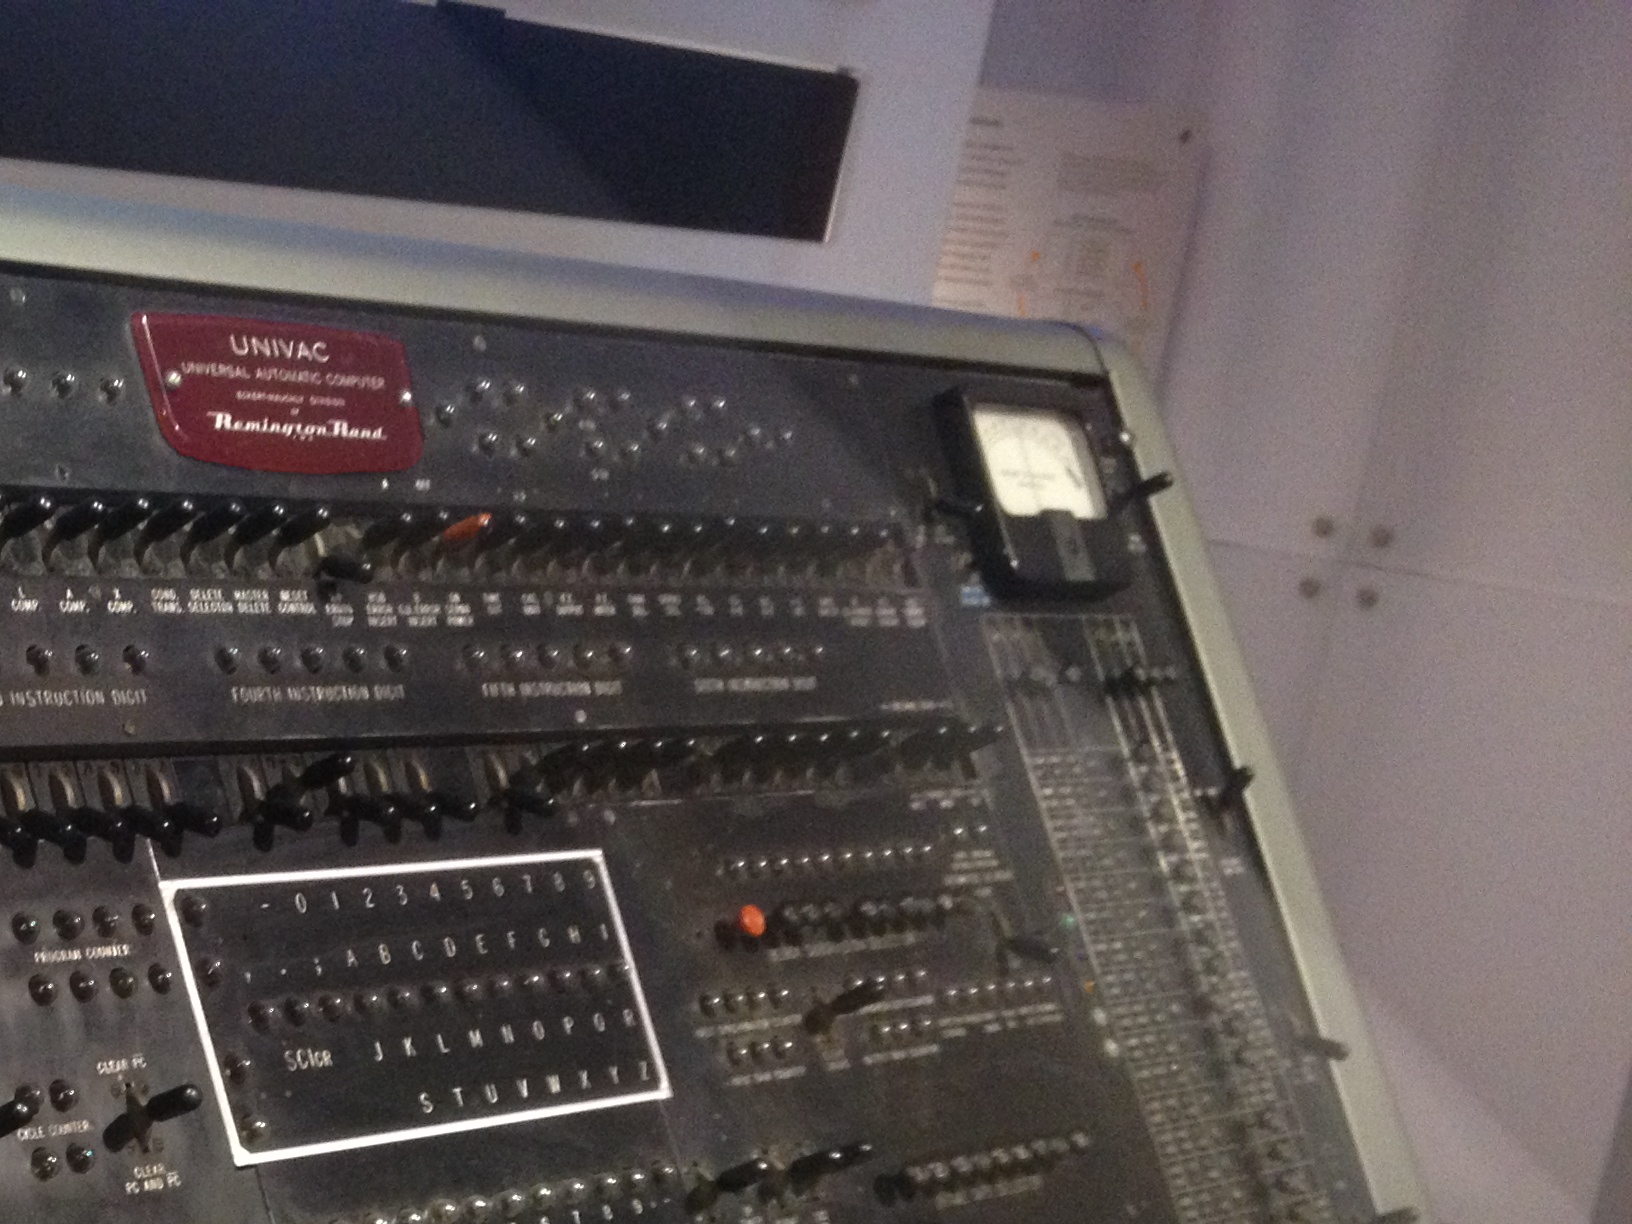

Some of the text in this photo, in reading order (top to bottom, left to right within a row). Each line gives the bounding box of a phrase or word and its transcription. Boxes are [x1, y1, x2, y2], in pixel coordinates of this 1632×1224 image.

[229, 334, 329, 363] UNIVAC
[206, 410, 387, 440] Remington Rand
[10, 690, 105, 708] INSTRUCTION
[363, 877, 505, 908] 2 3 5 6
[347, 930, 516, 968] A B C D E F
[374, 1015, 575, 1062] J K L P
[419, 1083, 498, 1114] S T U
